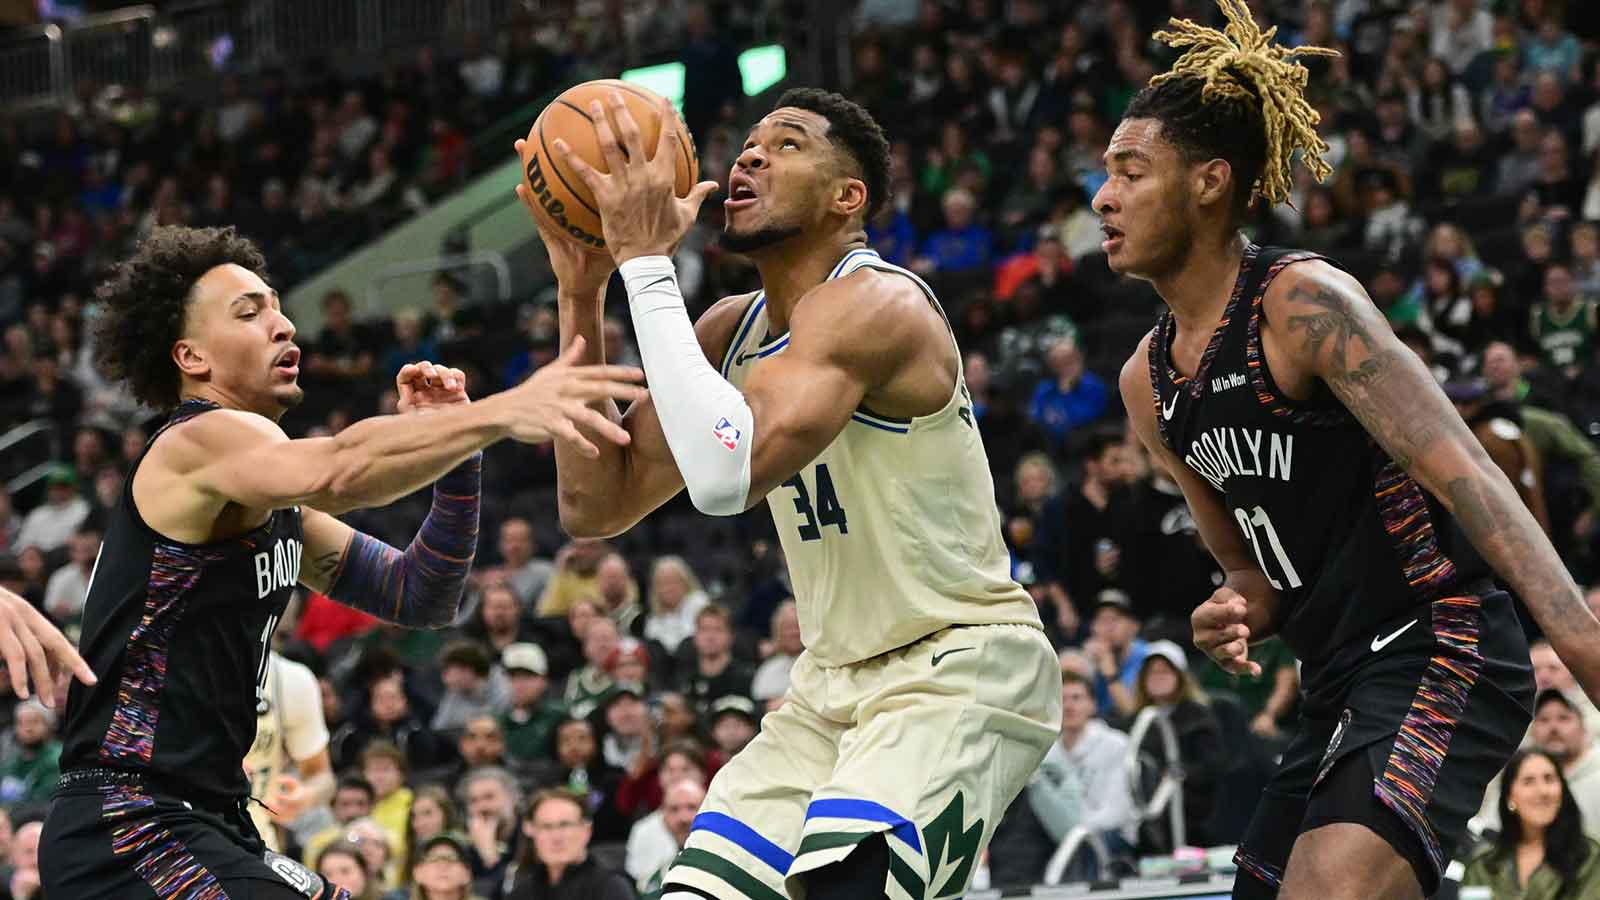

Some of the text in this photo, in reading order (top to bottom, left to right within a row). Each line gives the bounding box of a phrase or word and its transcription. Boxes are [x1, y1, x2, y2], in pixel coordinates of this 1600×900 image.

[527, 152, 606, 248] Wilson
[1211, 372, 1247, 393] All In Won
[1185, 427, 1293, 493] ROOKLYN
[781, 463, 848, 541] 34
[1234, 505, 1303, 591] 21
